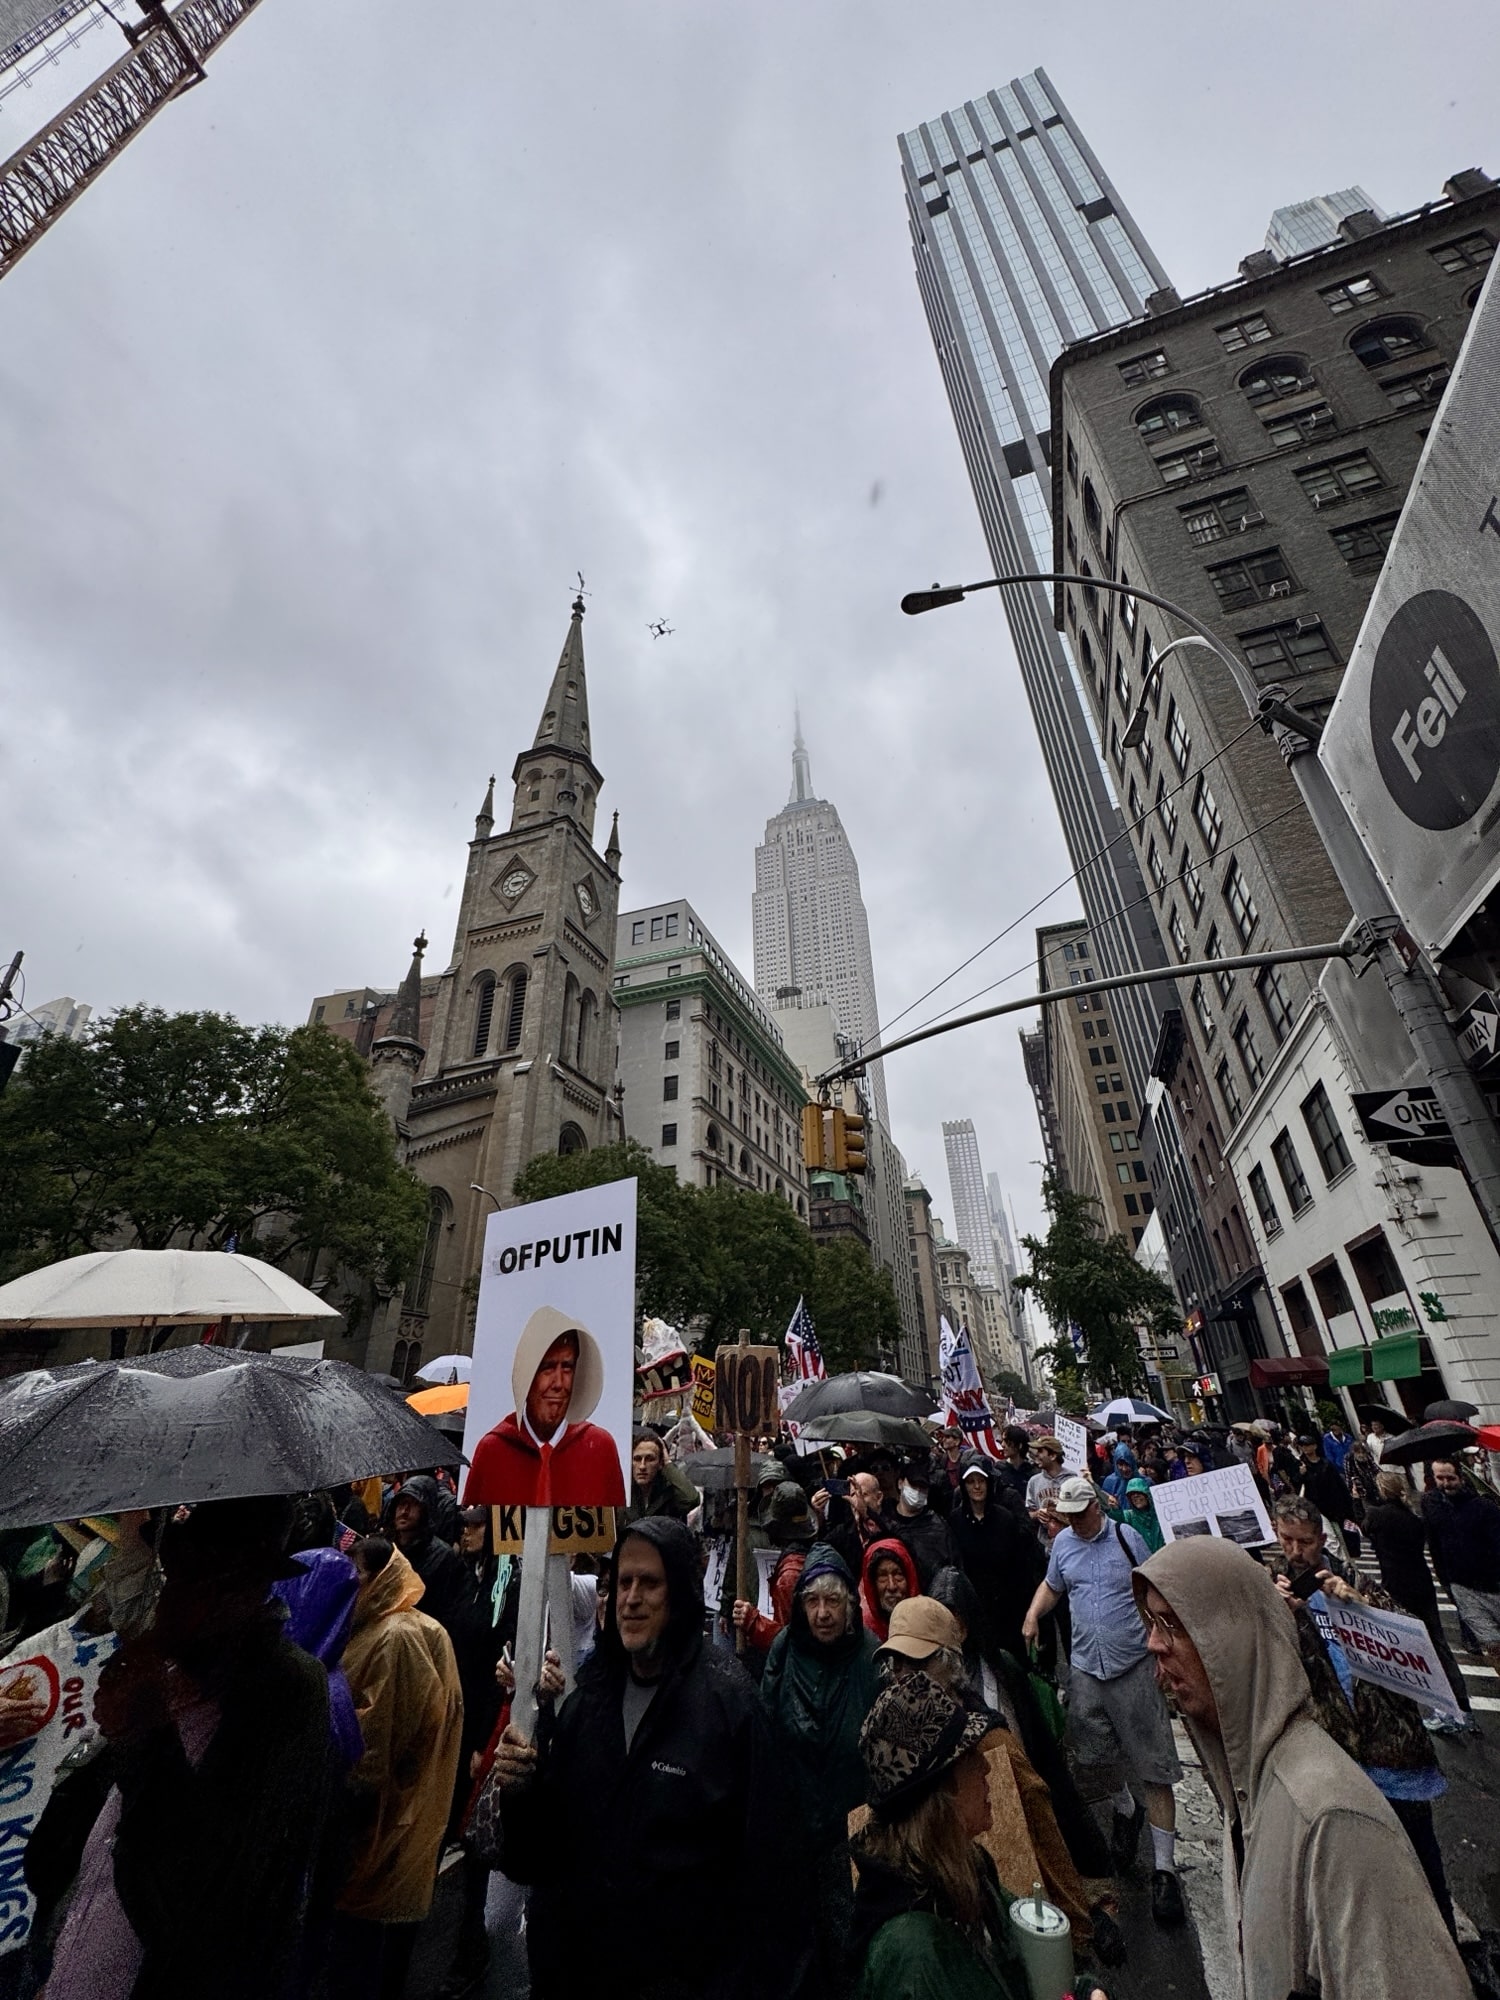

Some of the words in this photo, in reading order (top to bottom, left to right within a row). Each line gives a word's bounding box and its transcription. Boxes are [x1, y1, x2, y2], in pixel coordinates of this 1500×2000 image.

[1391, 645, 1467, 783] Feil
[1464, 1015, 1491, 1052] WAY
[1394, 1101, 1446, 1124] ONE
[500, 1223, 622, 1274] OFPUTIN
[716, 1354, 774, 1433] NO!
[1214, 1467, 1254, 1491] HANDS
[1163, 1503, 1182, 1521] OFF
[1188, 1496, 1212, 1516] OUR
[1214, 1486, 1255, 1510] LANDS
[1340, 1611, 1400, 1645] DEFEND
[1346, 1648, 1363, 1665] OF
[1367, 1655, 1432, 1690] SPEECH
[62, 1676, 86, 1739] OUR
[657, 1762, 686, 1776] Columbia
